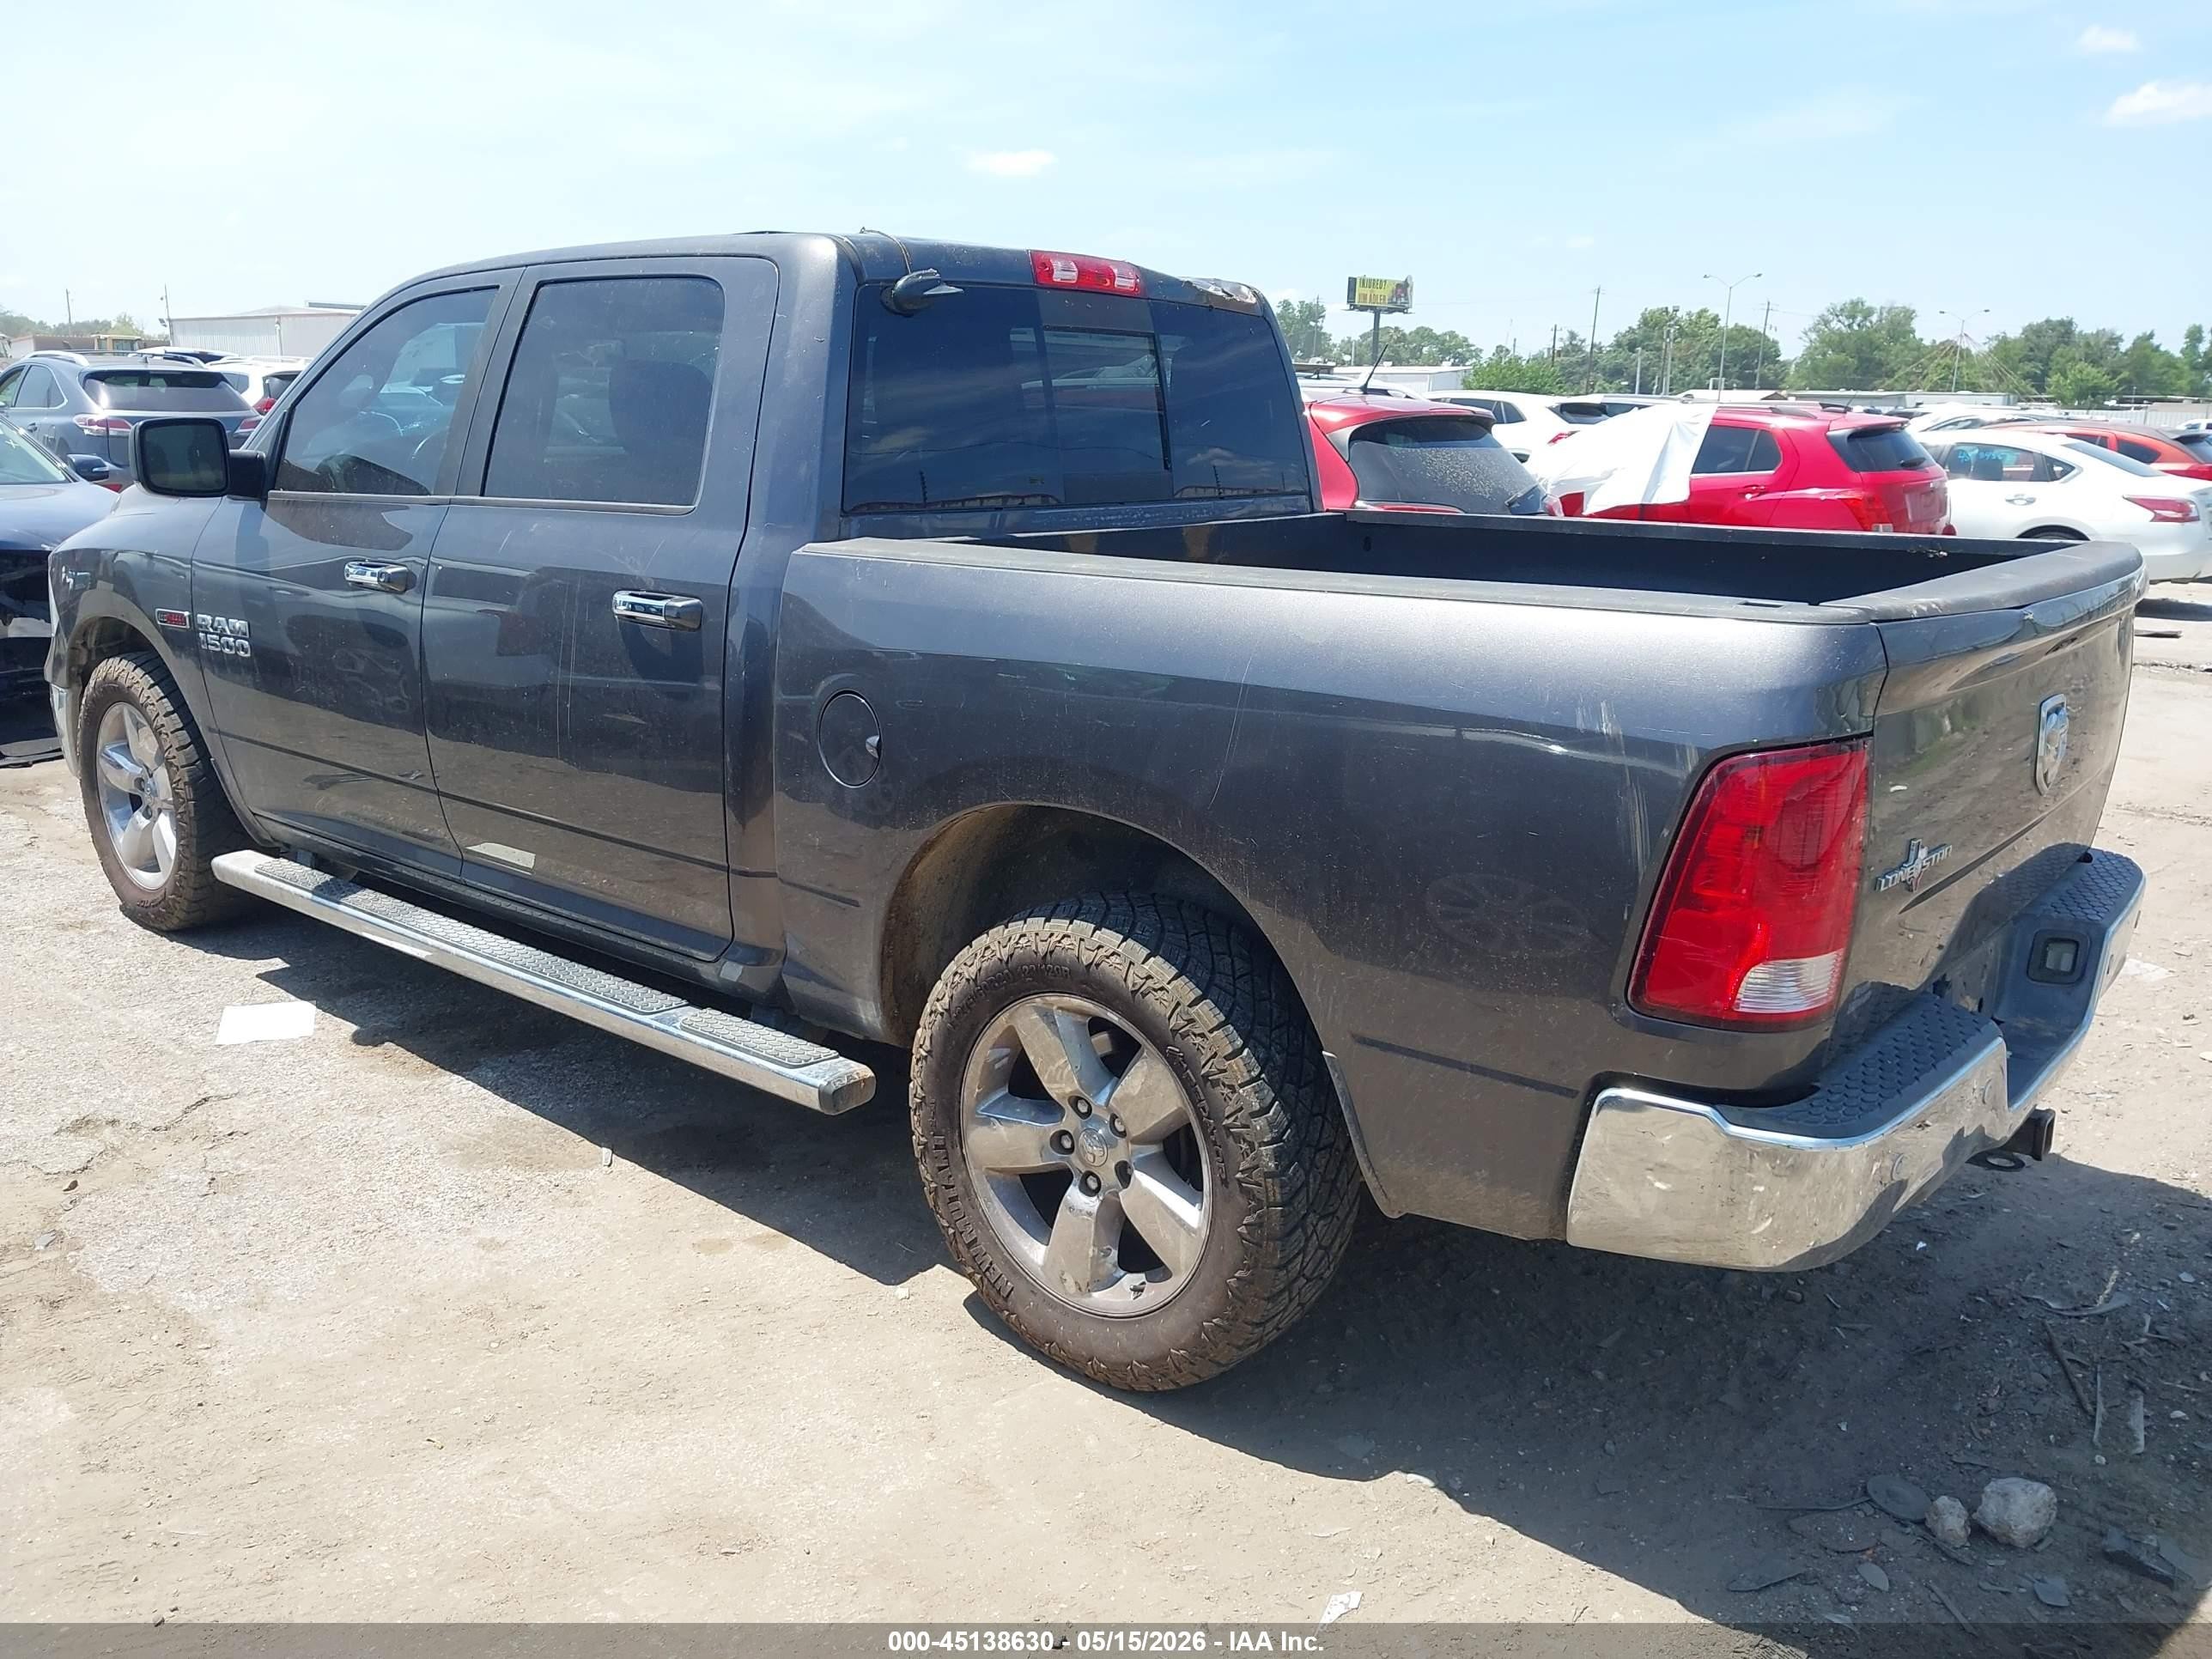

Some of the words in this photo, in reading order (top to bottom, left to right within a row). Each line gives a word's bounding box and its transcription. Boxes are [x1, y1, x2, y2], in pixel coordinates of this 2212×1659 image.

[1358, 277, 1387, 289] INJURED?
[197, 613, 250, 639] RAM
[198, 632, 252, 658] 1500
[1921, 844, 1953, 872] STAR
